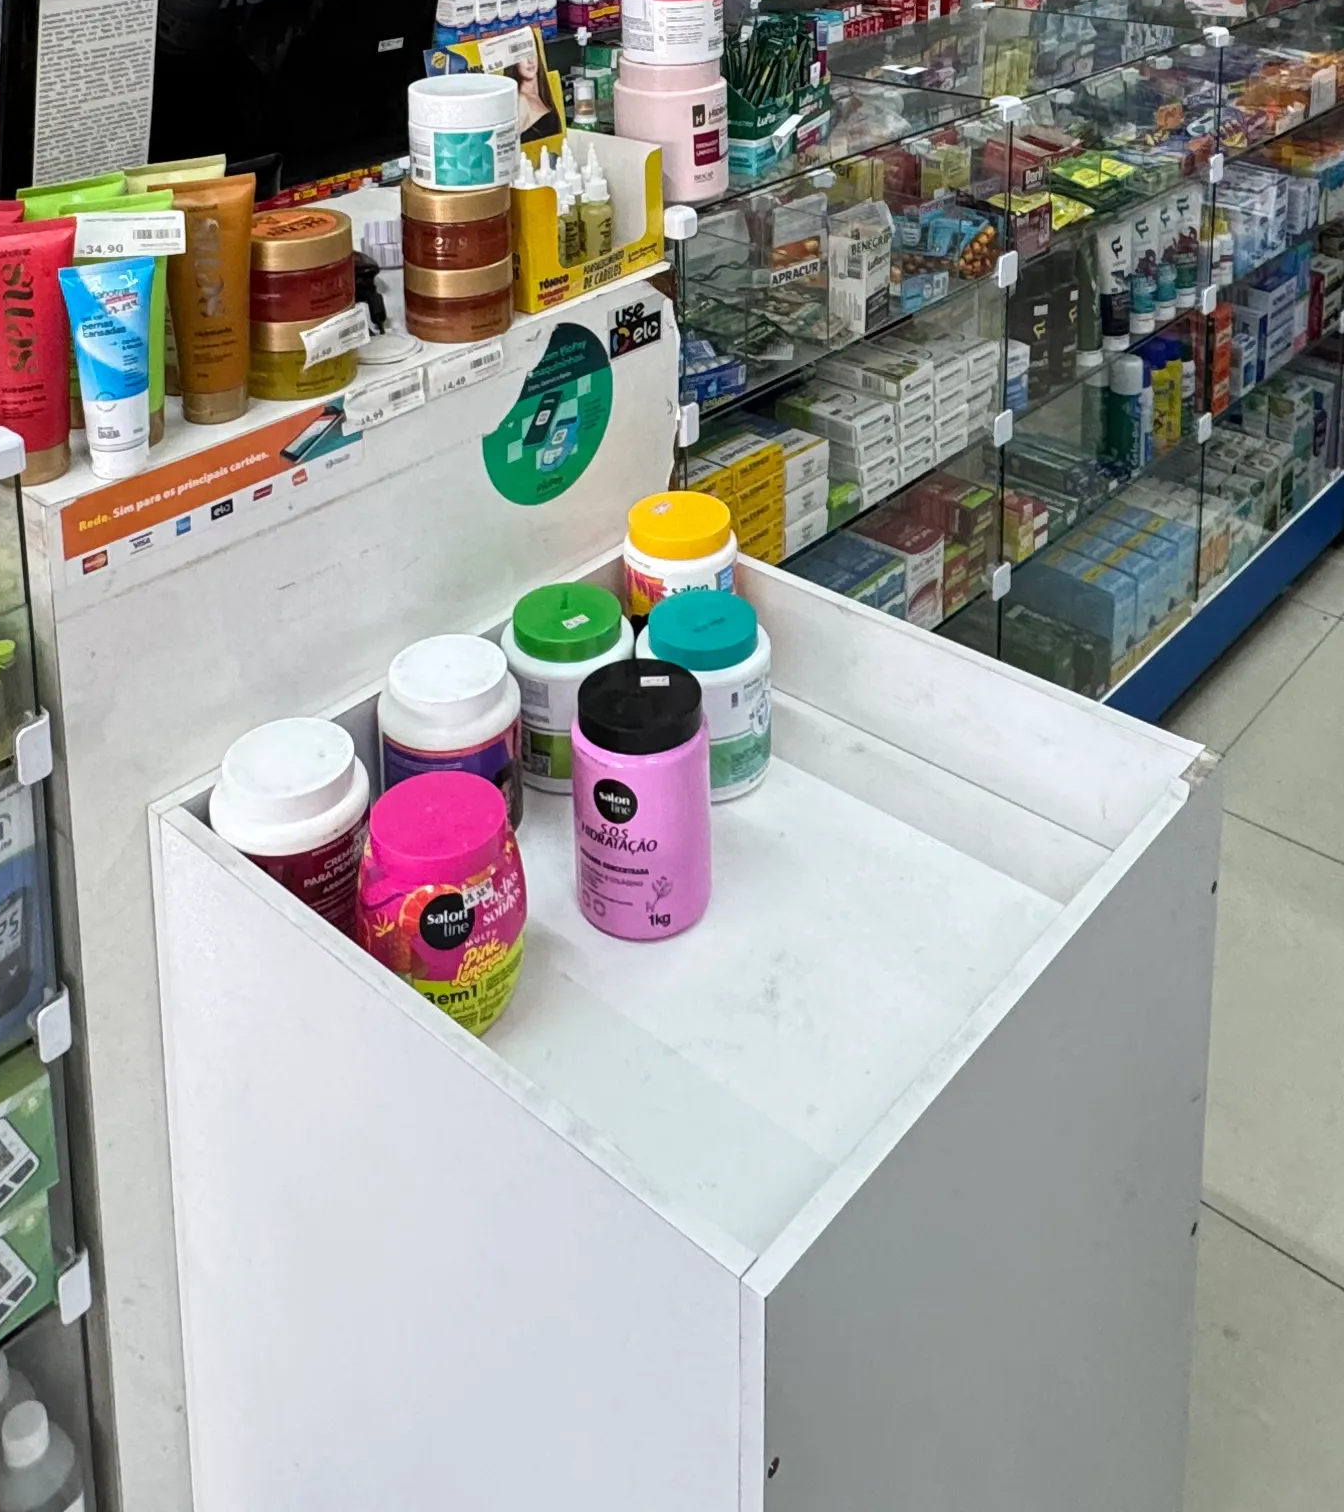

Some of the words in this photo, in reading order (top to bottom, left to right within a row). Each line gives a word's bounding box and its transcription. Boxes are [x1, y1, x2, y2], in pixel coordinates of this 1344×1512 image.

[85, 243, 124, 255] 34,90
[539, 273, 569, 293] TÔNICO
[770, 261, 820, 287] APRACUR
[1, 261, 37, 375] sens
[615, 300, 645, 327] use
[82, 320, 114, 333] pernas
[82, 327, 127, 339] cansadas
[632, 318, 660, 344] elo
[79, 514, 111, 532] Rede.
[112, 505, 135, 519] Sim
[136, 493, 161, 512] para
[163, 487, 175, 499] os
[177, 466, 229, 496] principais
[230, 451, 269, 476] cartões.
[213, 503, 231, 518] elo
[598, 789, 631, 806] salon
[611, 802, 632, 816] line
[581, 822, 658, 856] HIDRATAÇÃO
[303, 870, 333, 888] PARA
[427, 906, 468, 924] salon
[649, 911, 671, 928] 1kg
[444, 921, 469, 937] line
[463, 939, 500, 970] Pink
